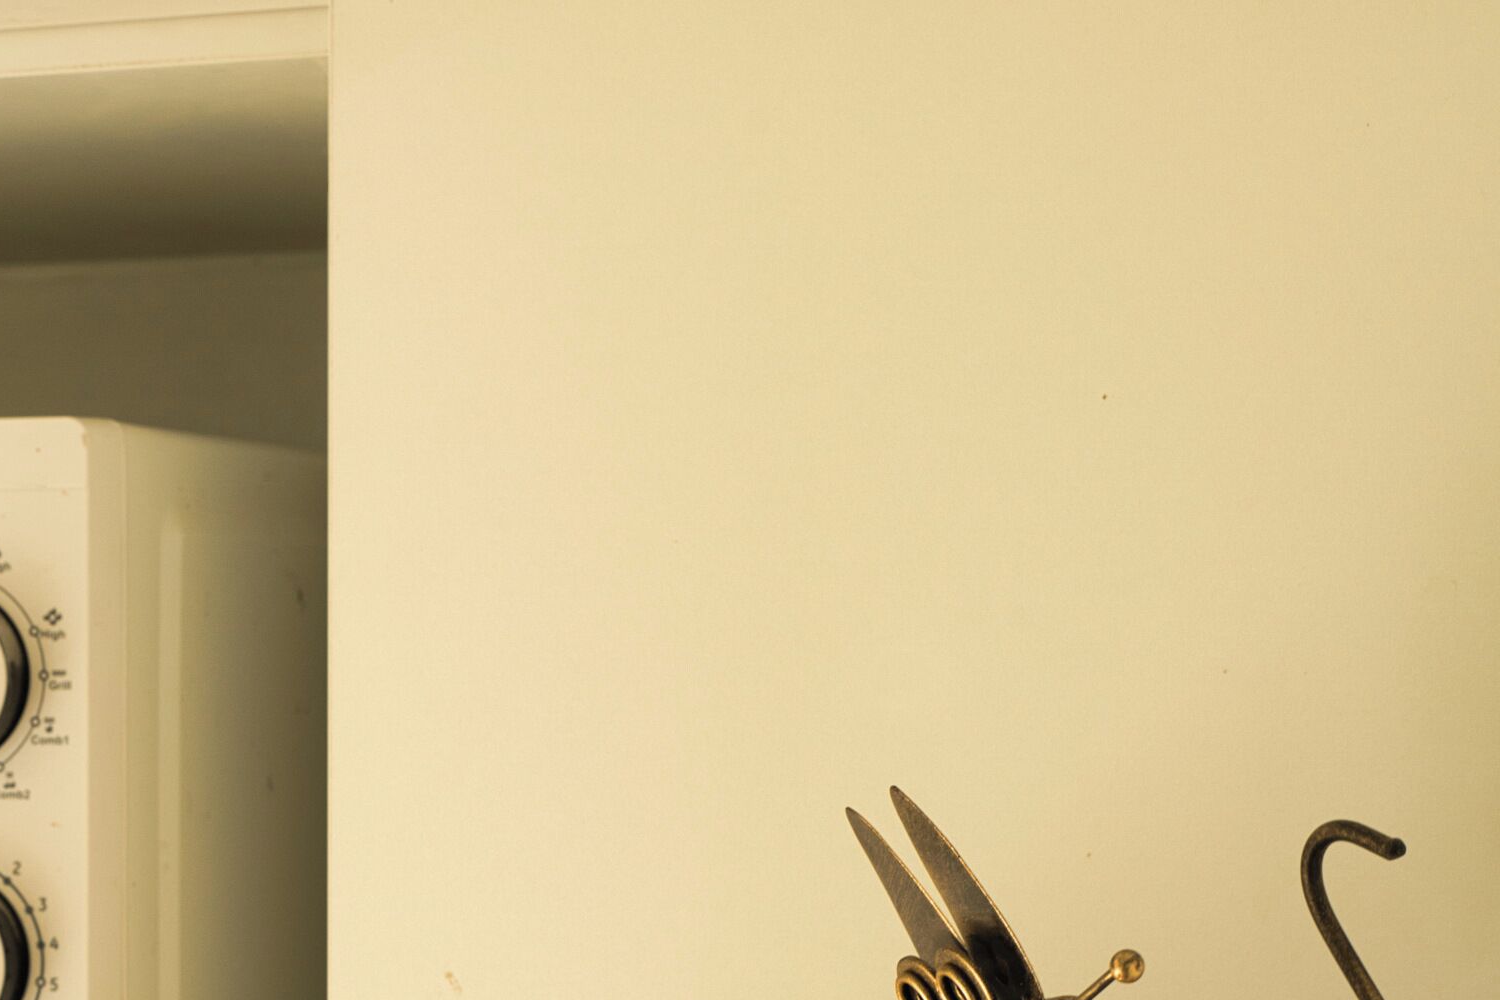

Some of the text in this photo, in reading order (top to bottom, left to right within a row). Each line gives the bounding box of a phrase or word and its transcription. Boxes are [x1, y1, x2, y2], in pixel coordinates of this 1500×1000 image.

[41, 629, 66, 640] High
[49, 680, 72, 691] Grill
[31, 735, 69, 745] Comb1
[12, 861, 22, 875] 2
[38, 898, 47, 912] 3
[50, 937, 59, 950] 4
[50, 977, 59, 991] 5
